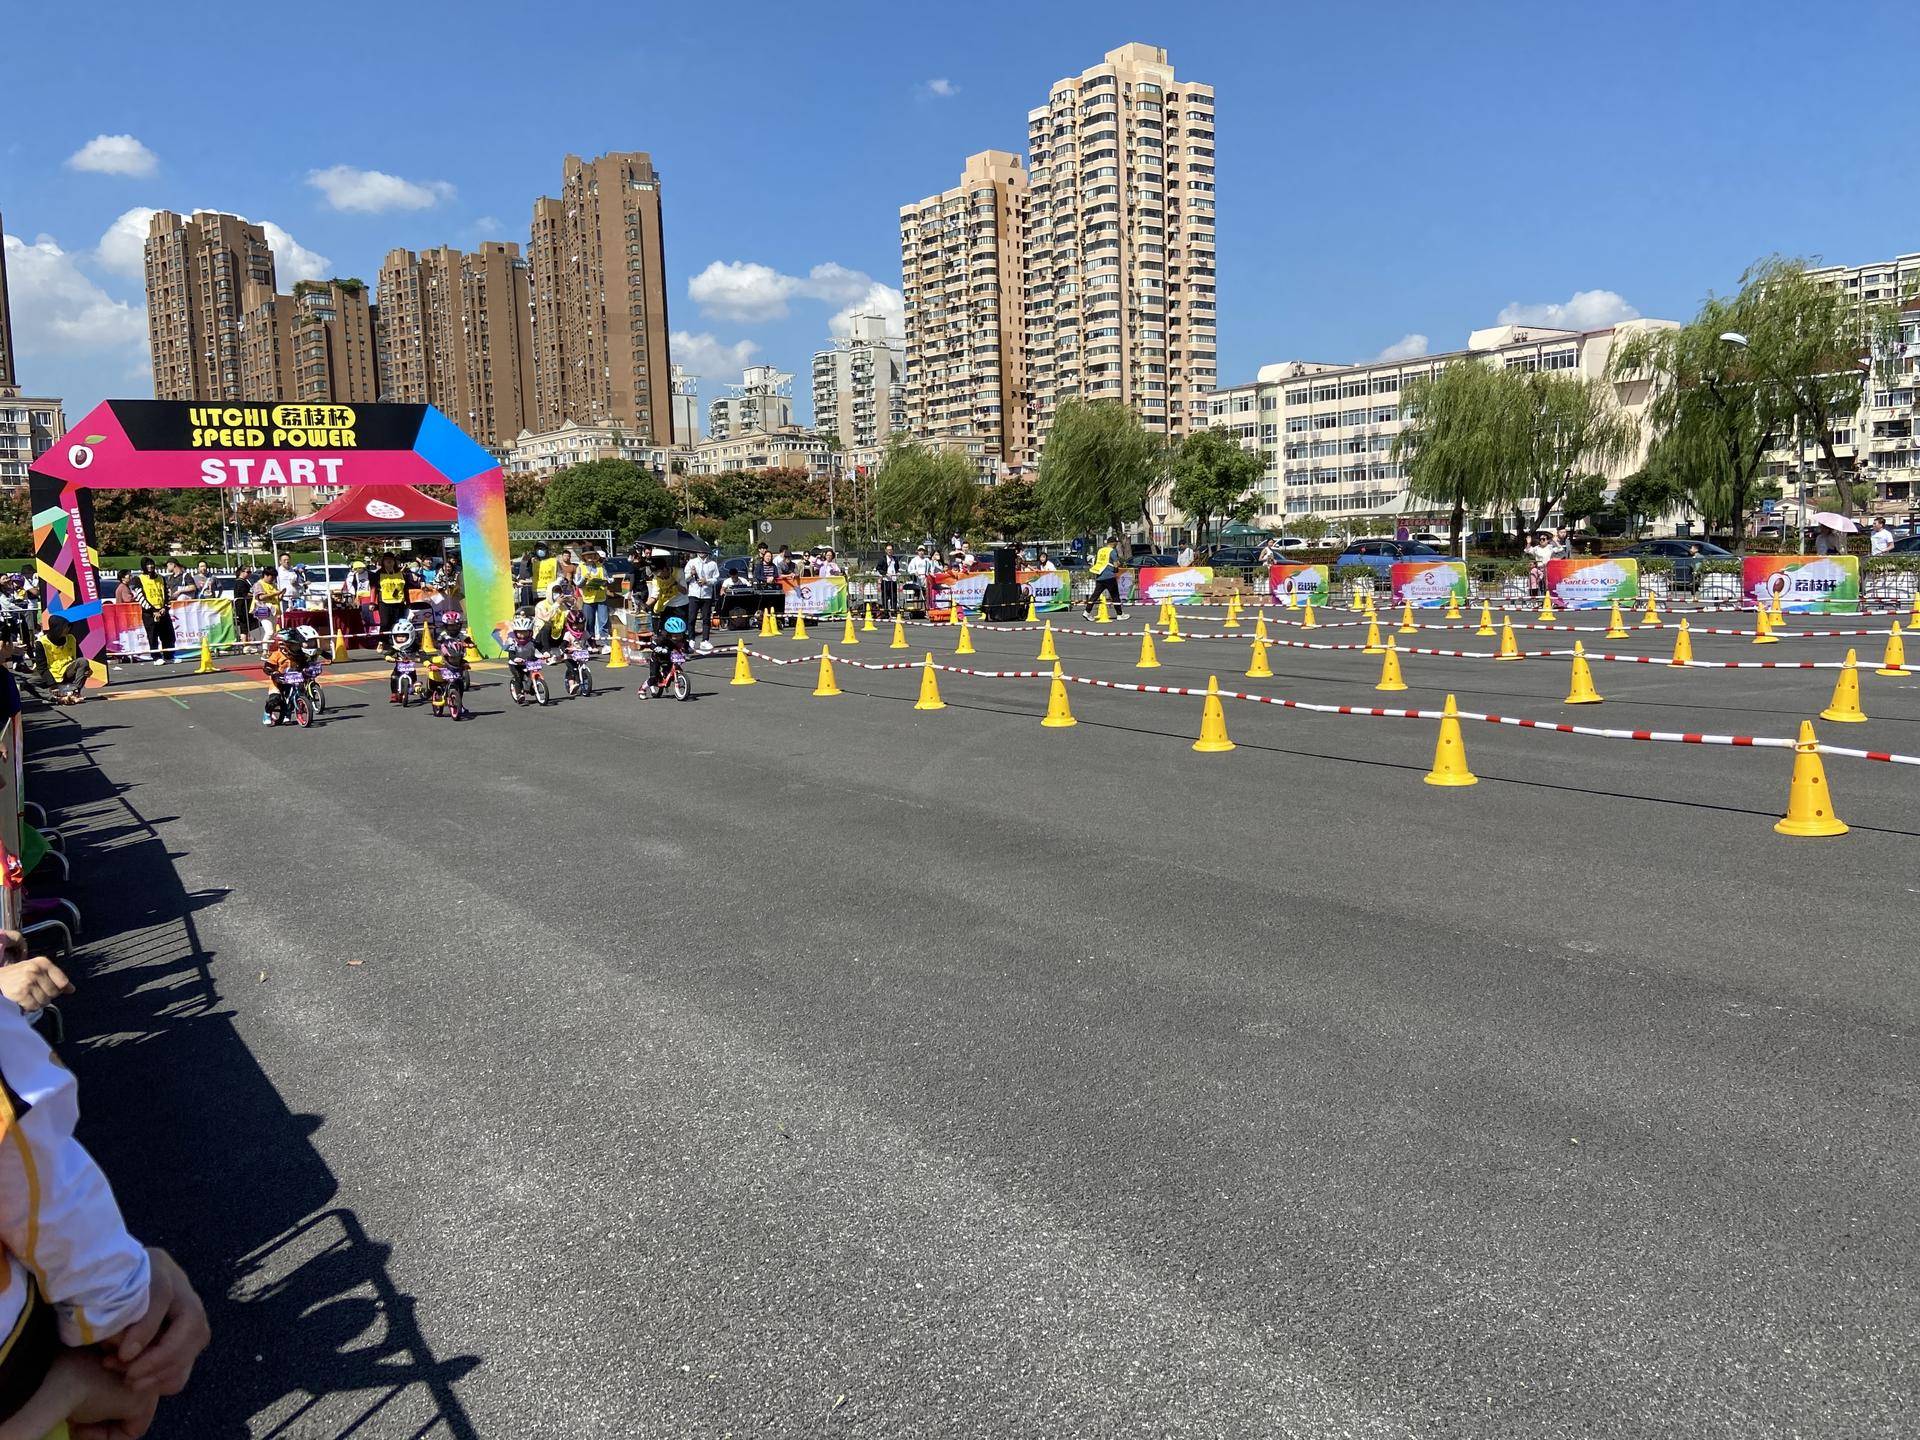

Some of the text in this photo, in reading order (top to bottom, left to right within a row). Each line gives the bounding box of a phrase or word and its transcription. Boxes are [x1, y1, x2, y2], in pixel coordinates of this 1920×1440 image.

[189, 407, 349, 427] LITCHI 荔枝杯
[192, 428, 357, 447] SPEED POWER
[200, 458, 344, 485] START
[70, 507, 98, 600] LITCHI SPEED POWER
[1795, 579, 1837, 592] 荔枝杯
